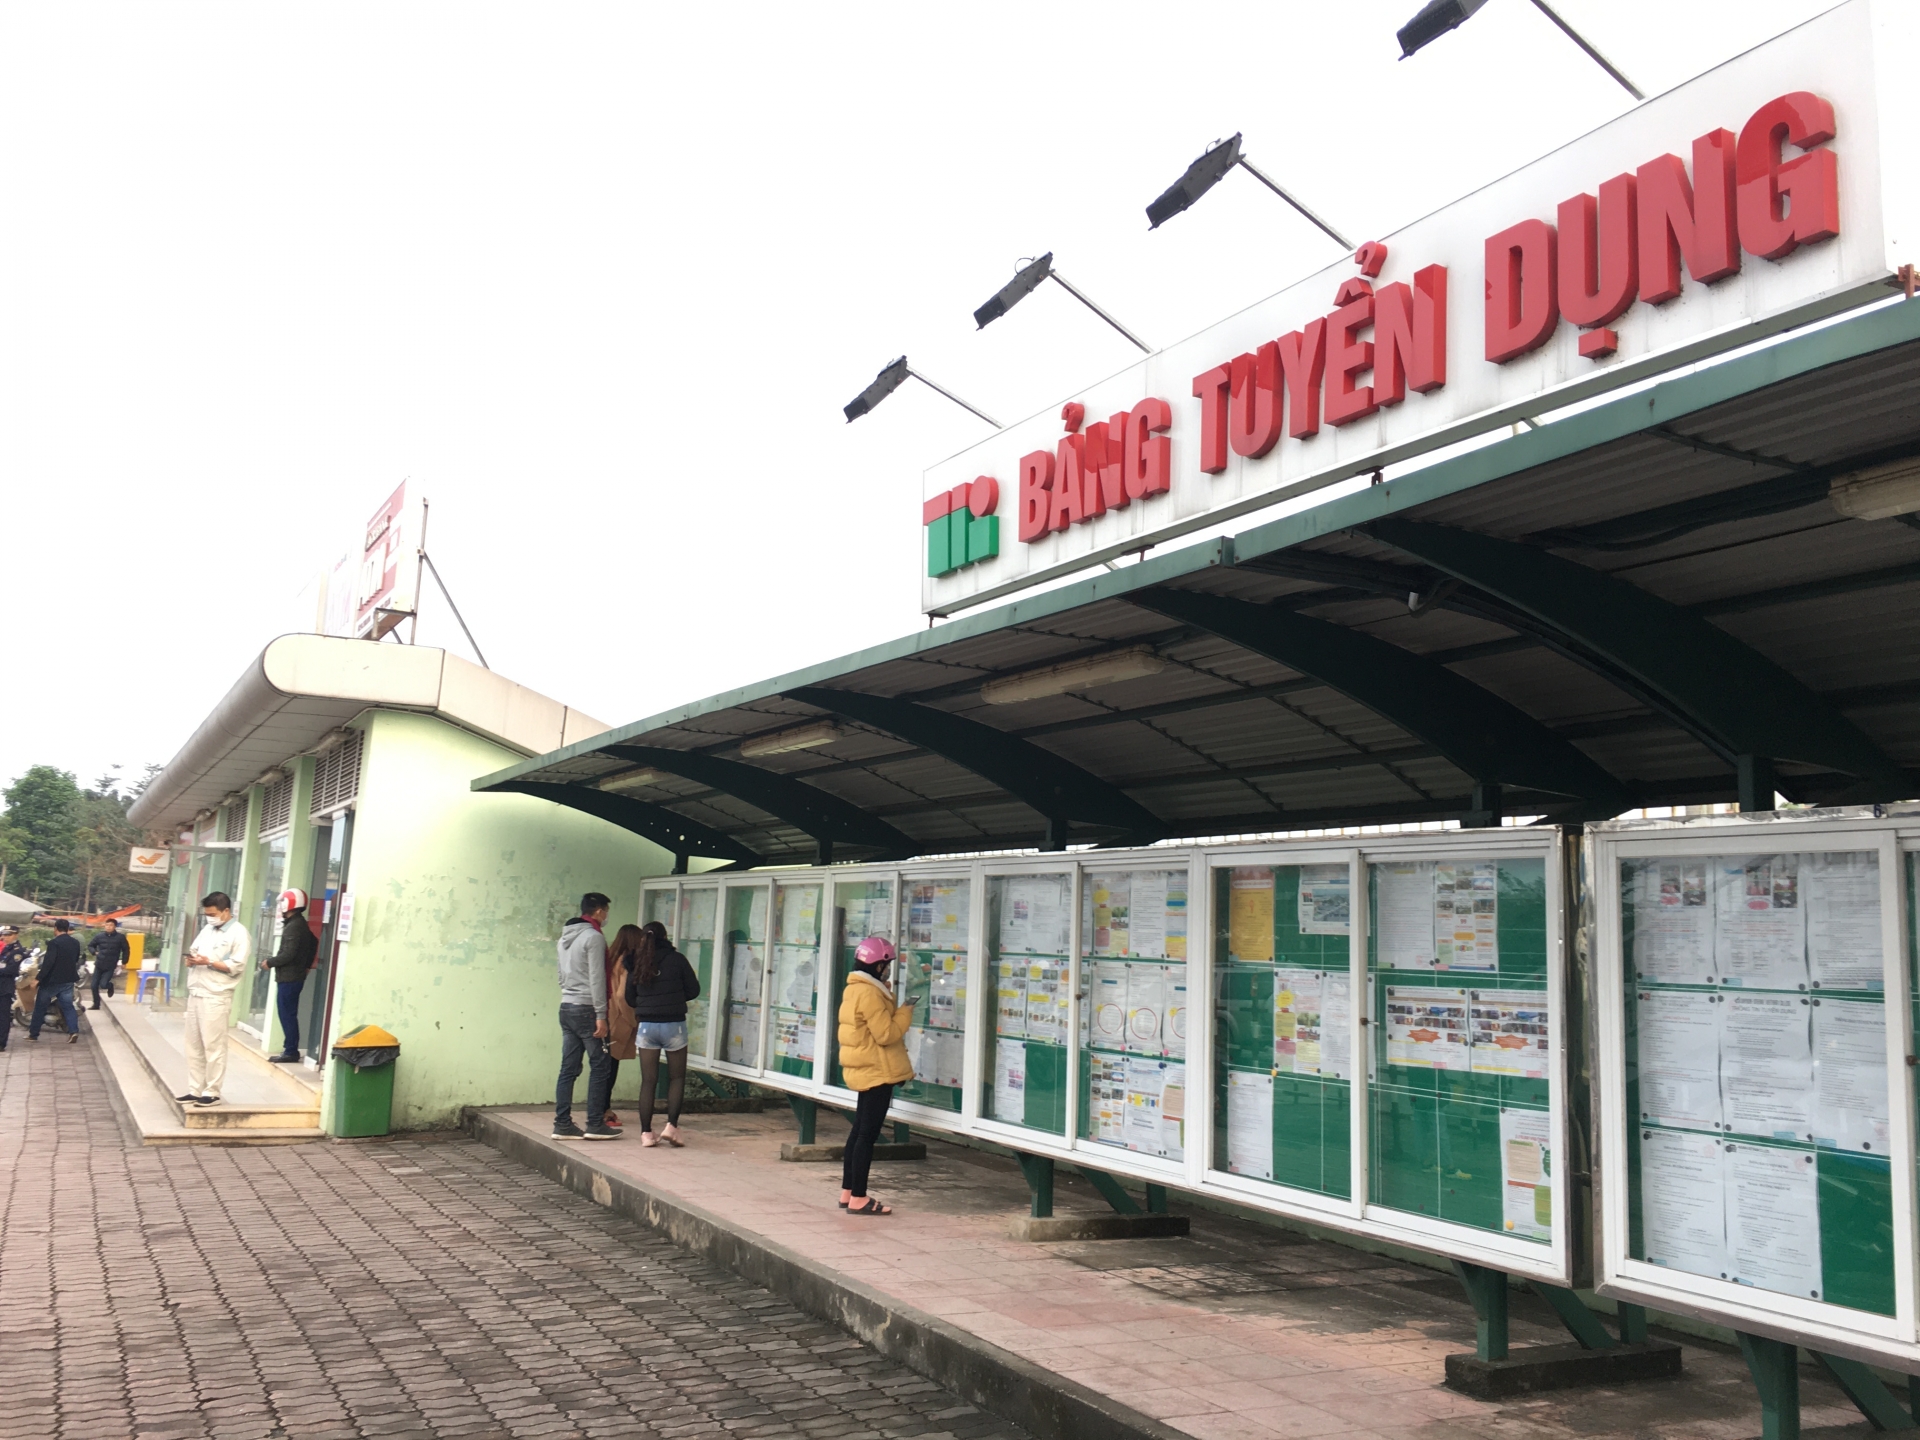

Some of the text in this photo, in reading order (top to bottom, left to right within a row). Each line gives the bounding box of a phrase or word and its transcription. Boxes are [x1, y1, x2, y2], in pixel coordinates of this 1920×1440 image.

[1018, 91, 1839, 544] BẢNG TUYỂN DỤNG
